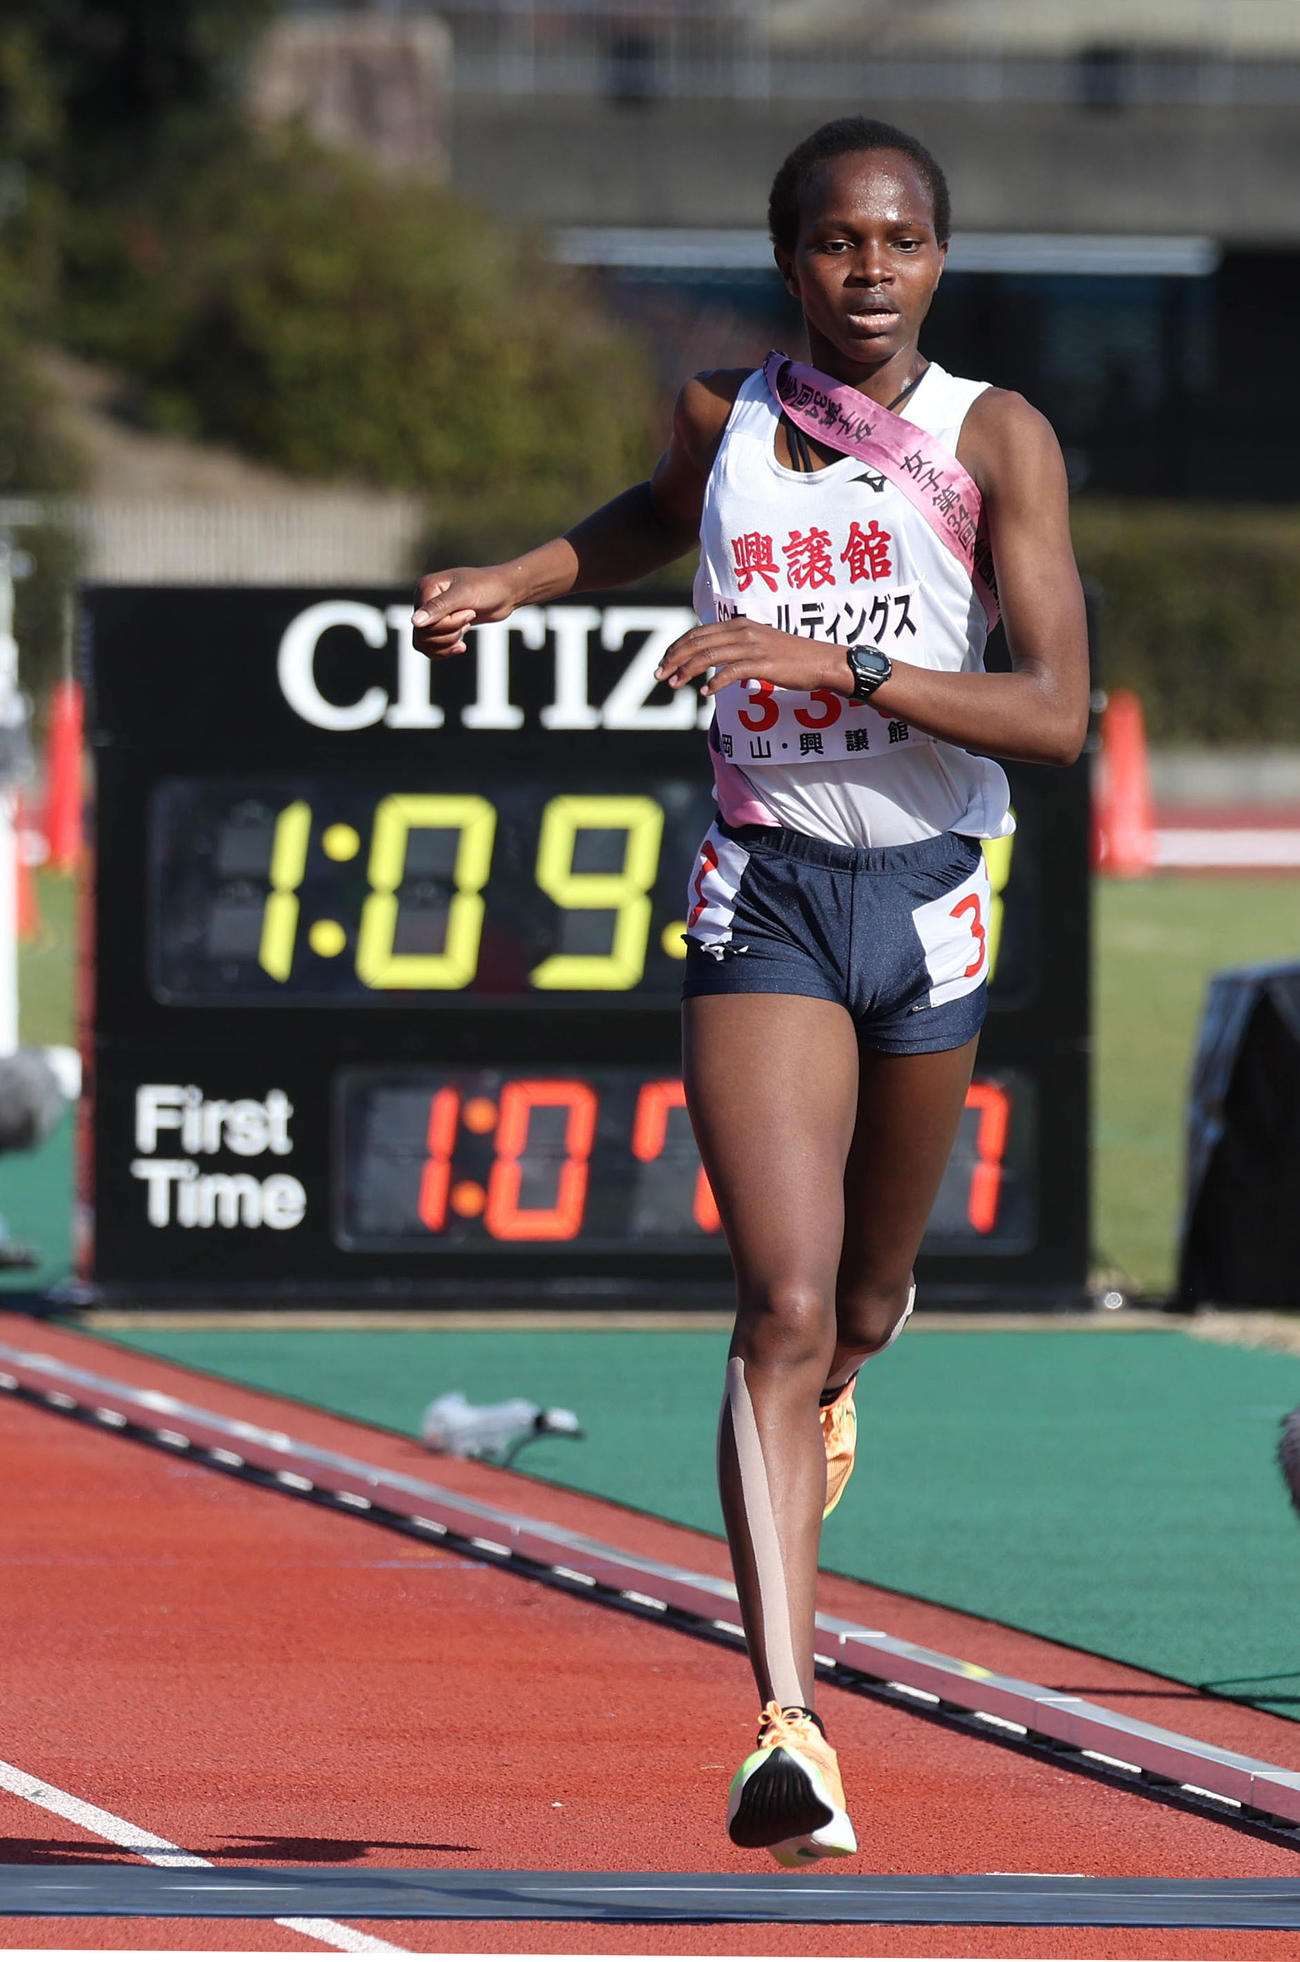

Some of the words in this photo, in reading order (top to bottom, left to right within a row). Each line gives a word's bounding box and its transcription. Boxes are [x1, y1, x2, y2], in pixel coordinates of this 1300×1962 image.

[731, 520, 892, 592] 興譲館
[278, 600, 718, 731] CITIZ
[950, 893, 985, 977] 3
[135, 1084, 294, 1155] First
[130, 1159, 307, 1230] Time
